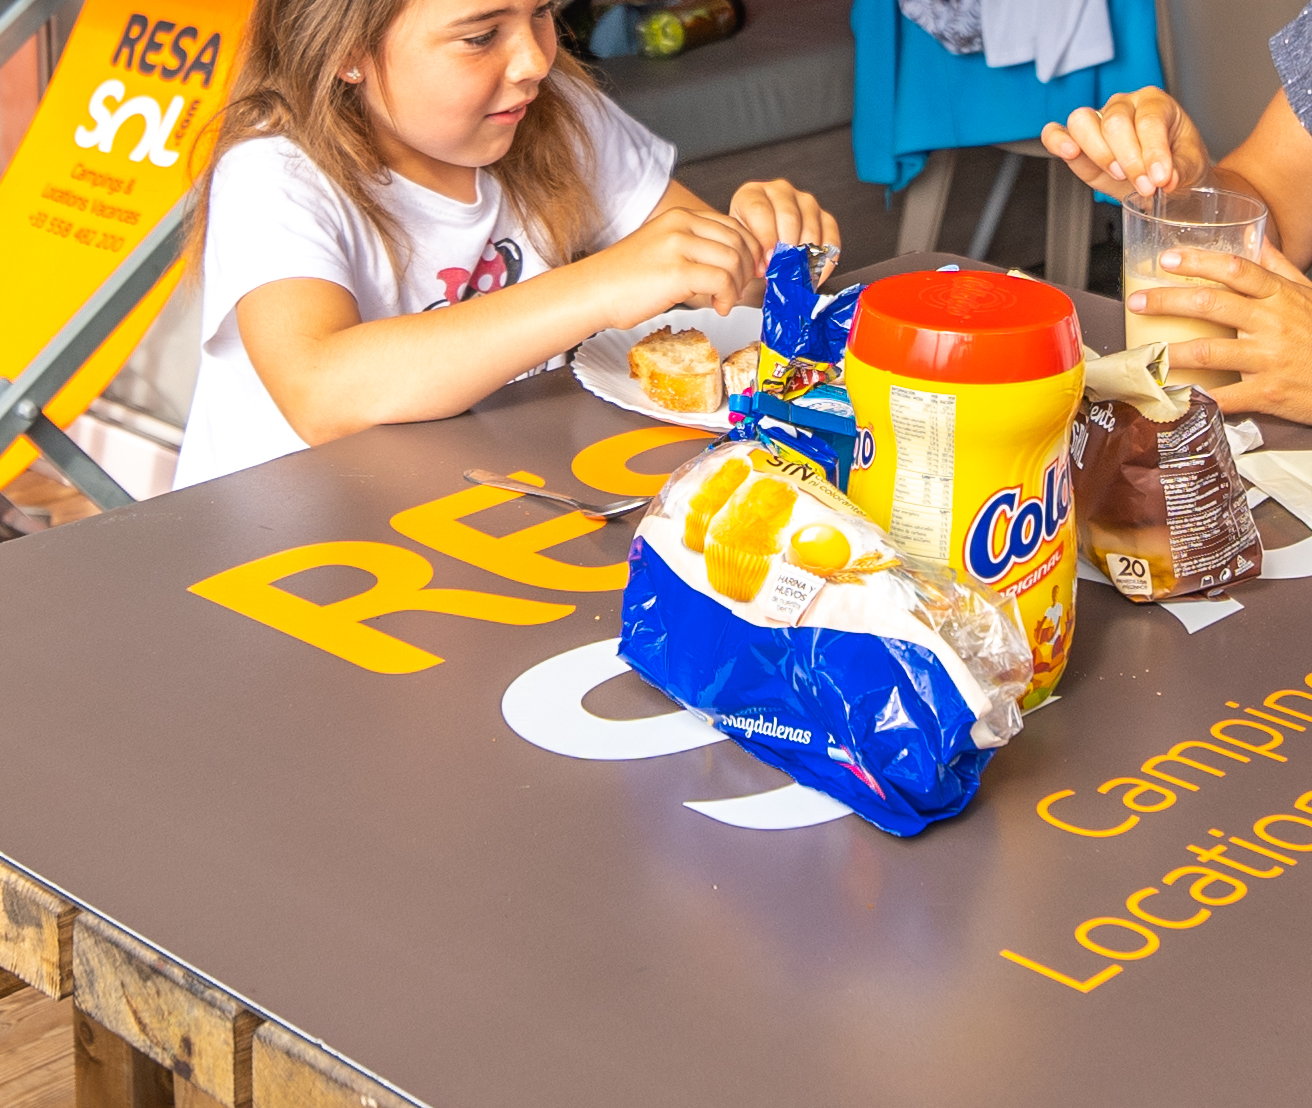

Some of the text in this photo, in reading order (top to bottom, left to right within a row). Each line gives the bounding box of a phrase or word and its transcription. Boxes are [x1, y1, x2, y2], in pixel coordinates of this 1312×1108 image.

[112, 12, 222, 89] RESA
[766, 455, 815, 482] SIN
[1000, 551, 1062, 598] RIGINAL
[1118, 556, 1146, 578] 20
[775, 584, 808, 602] HUEVOS
